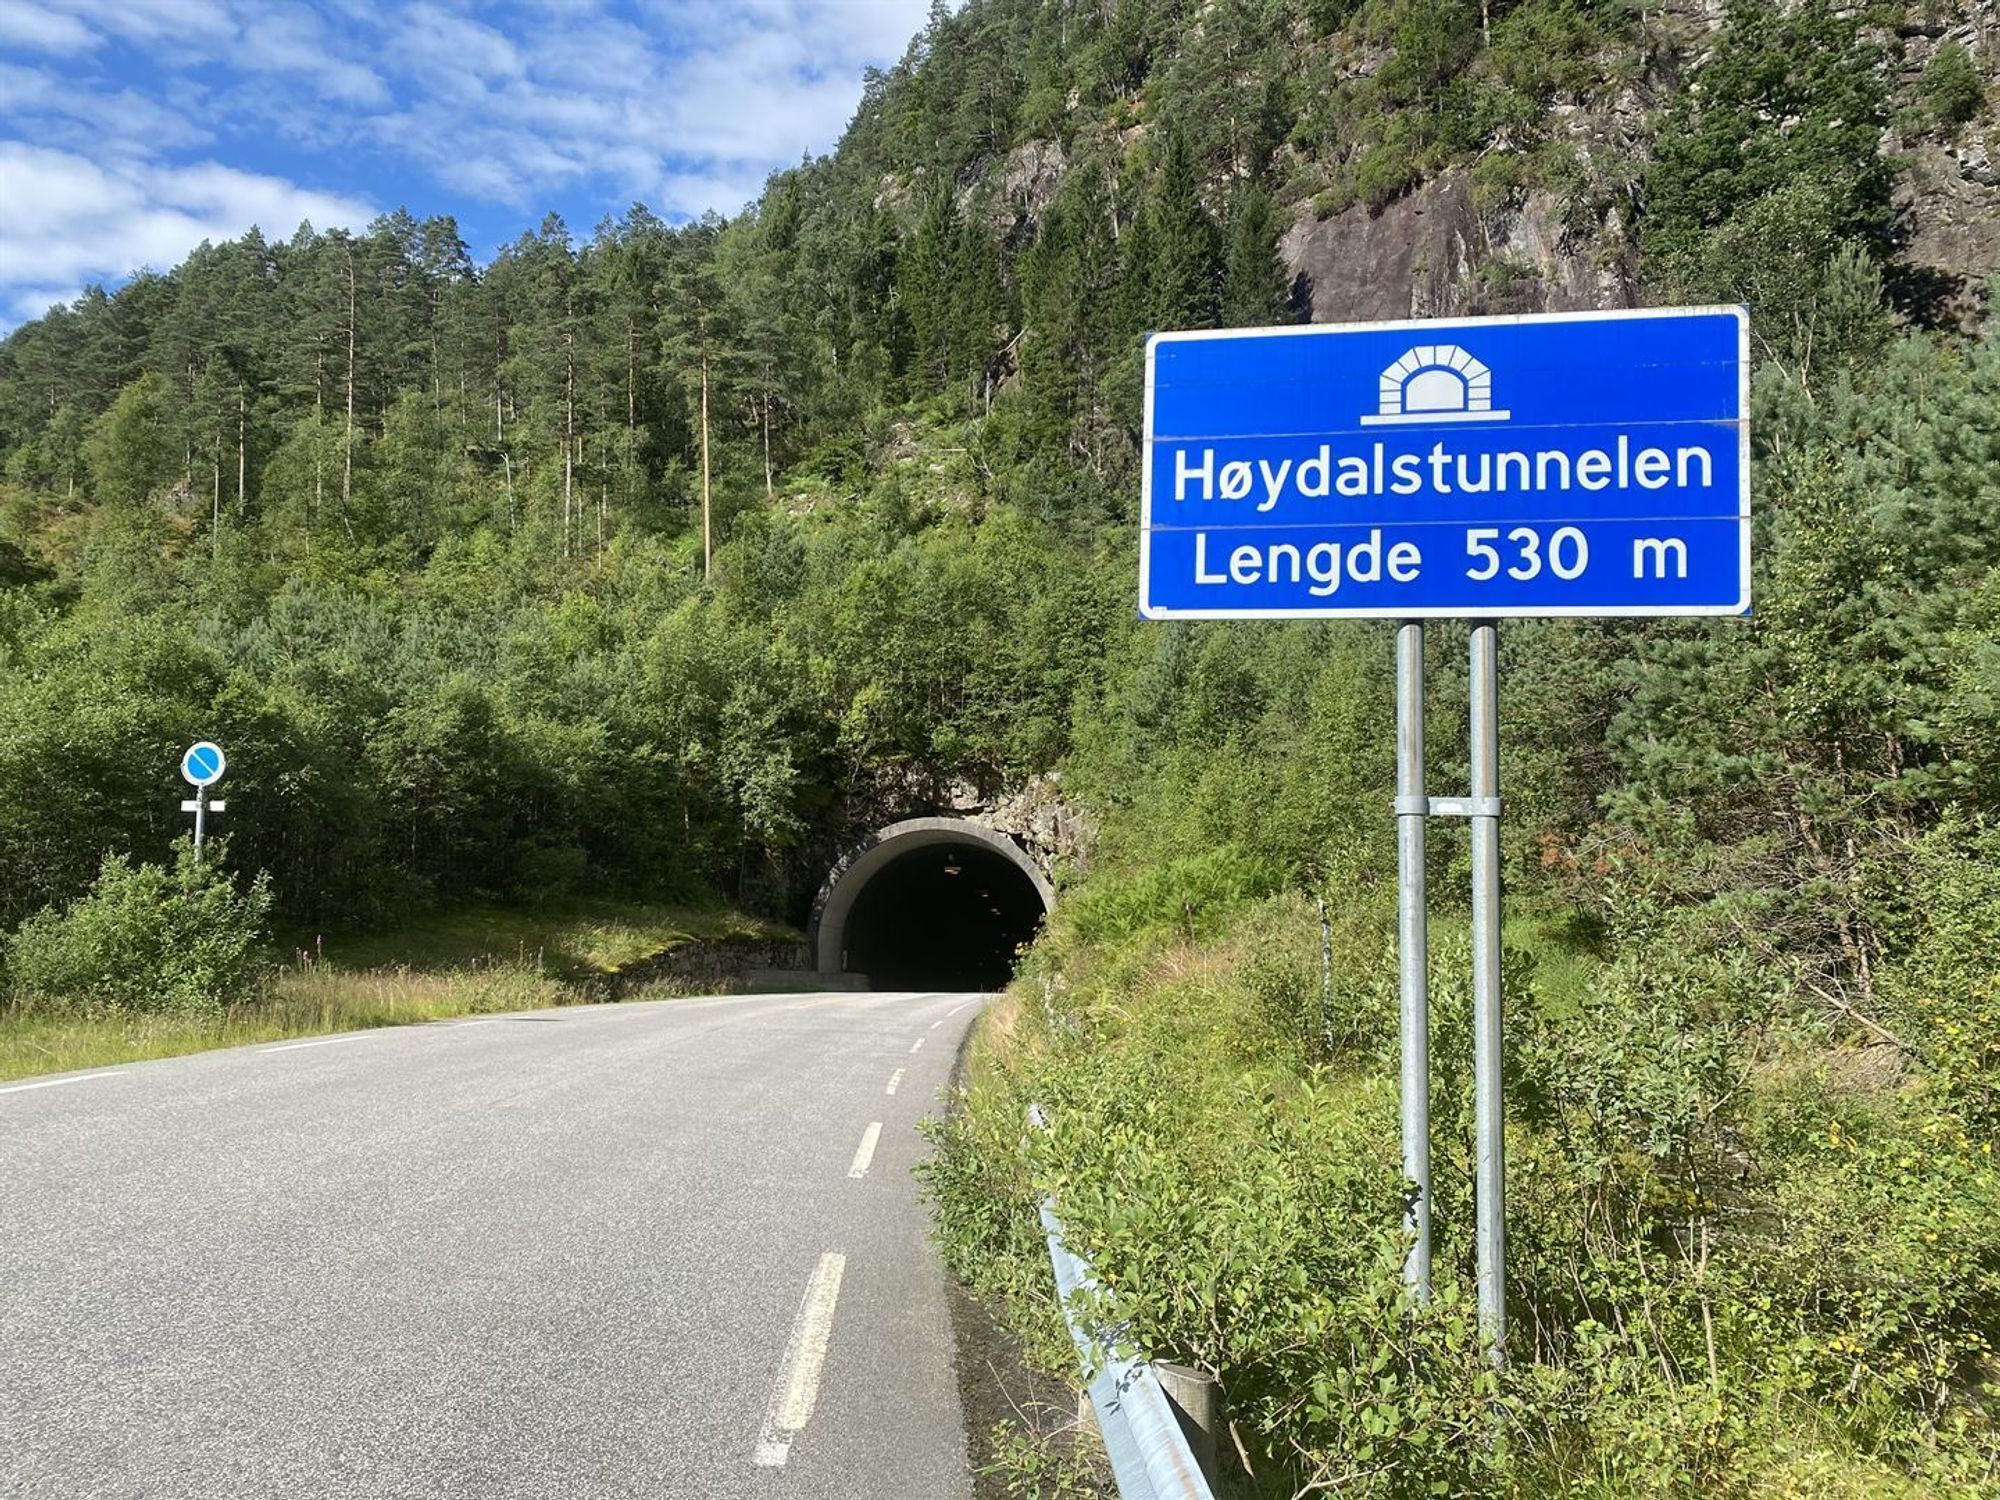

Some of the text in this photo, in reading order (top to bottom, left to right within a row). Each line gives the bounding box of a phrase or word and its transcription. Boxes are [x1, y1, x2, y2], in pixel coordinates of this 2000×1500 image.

[1174, 435, 1713, 512] Høydalstunnelen
[1195, 527, 1687, 596] Lengde 530 m
